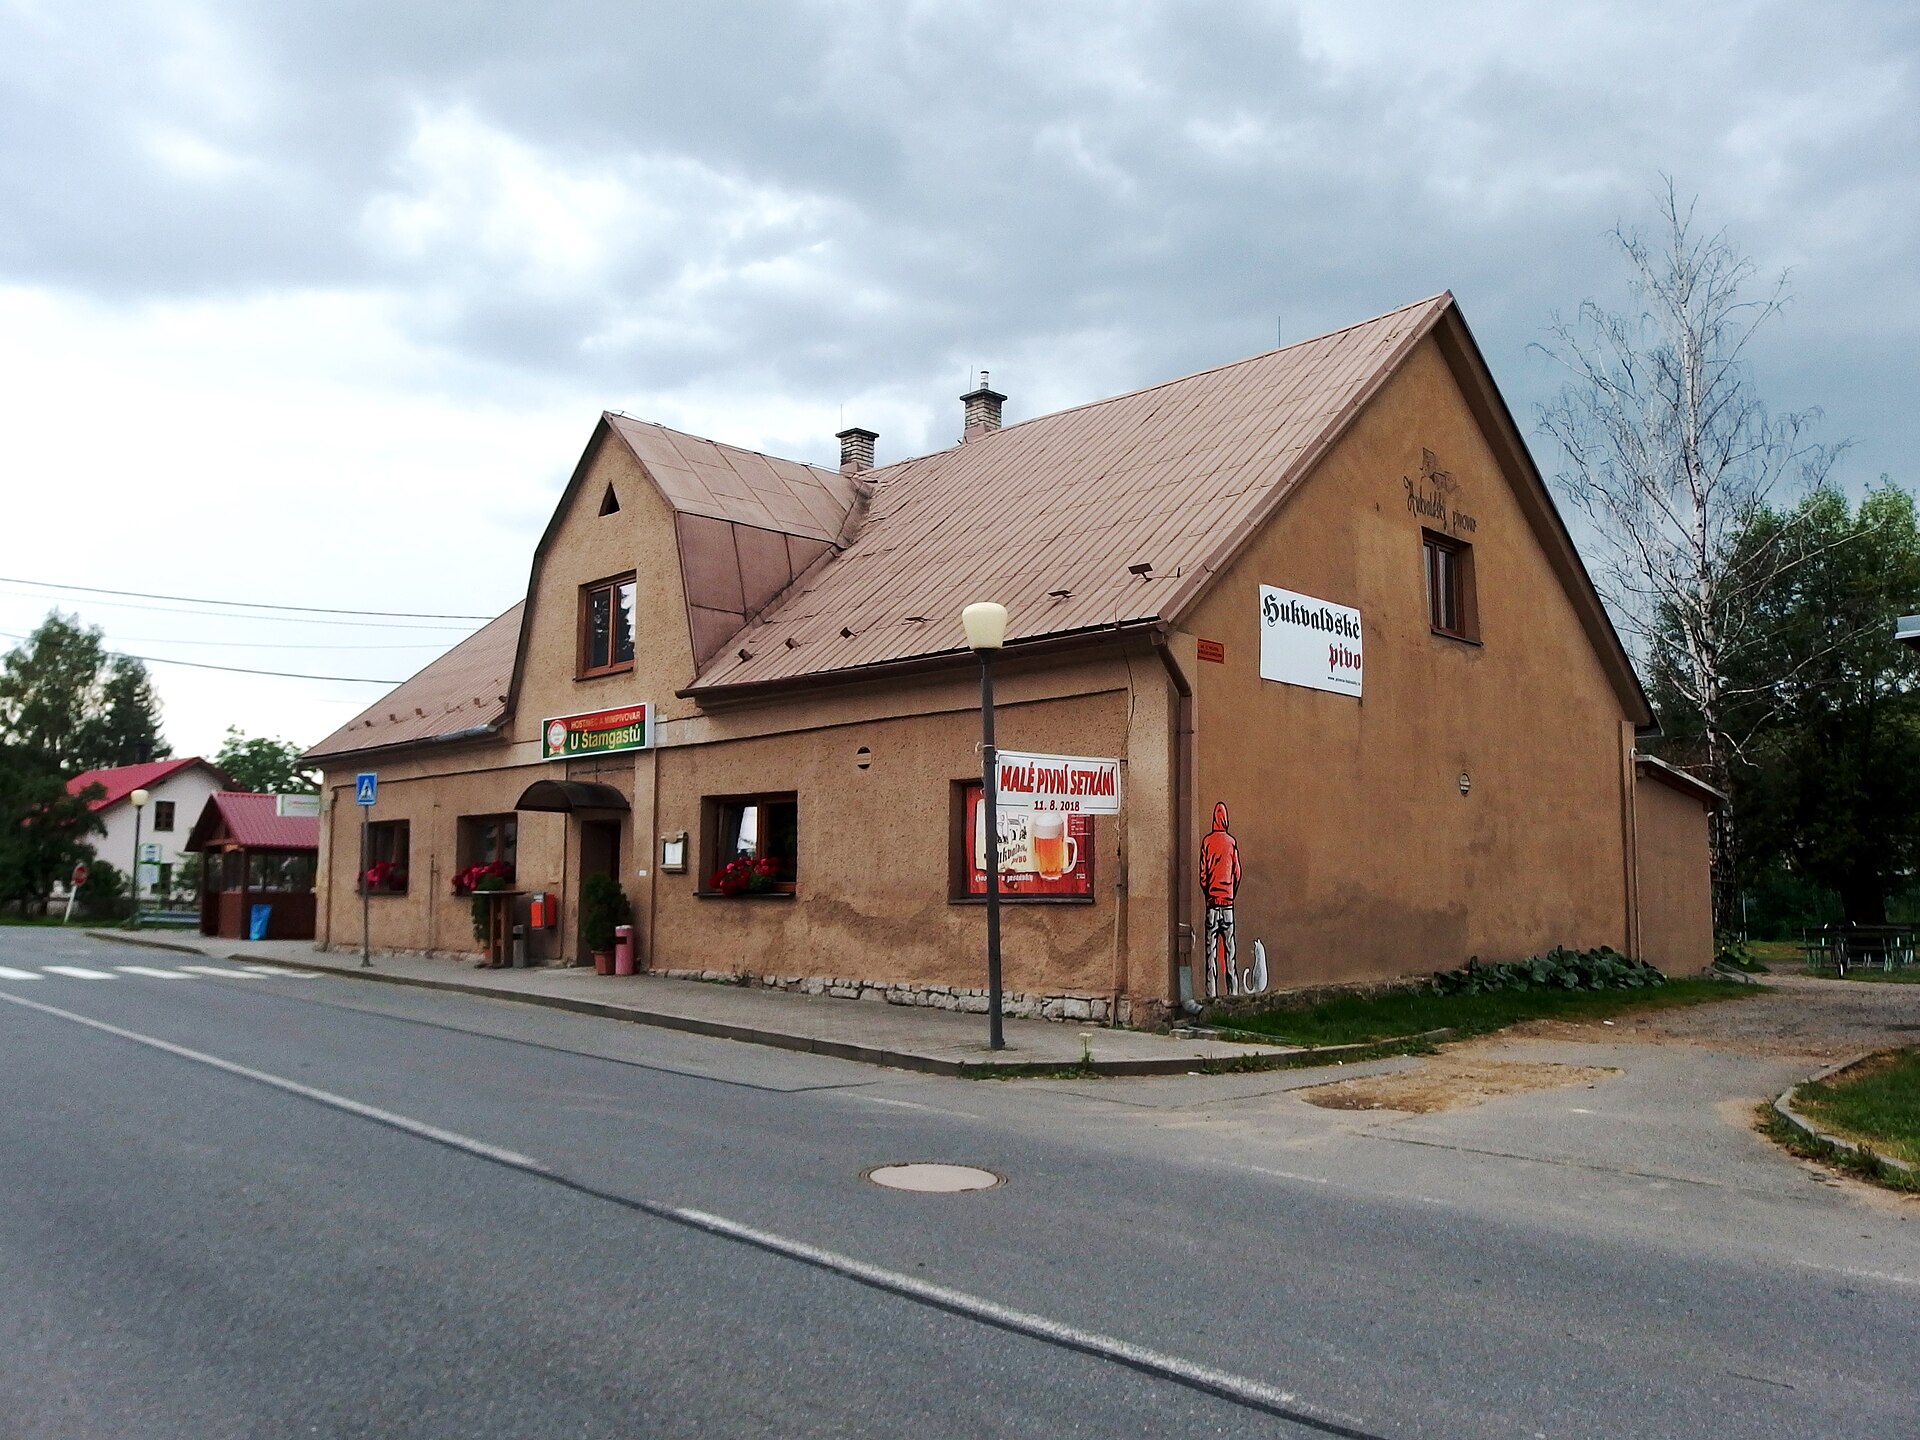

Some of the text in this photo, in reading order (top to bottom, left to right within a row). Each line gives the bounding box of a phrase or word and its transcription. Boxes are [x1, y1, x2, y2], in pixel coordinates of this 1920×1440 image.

[1263, 594, 1360, 640] Hukvaldské
[1328, 643, 1361, 673] pivo
[570, 724, 640, 750] U Štamgastů
[1001, 762, 1115, 796] MALÉ PIVNÍ SETKÁNÍ
[1034, 800, 1080, 811] 11. 8. 2018
